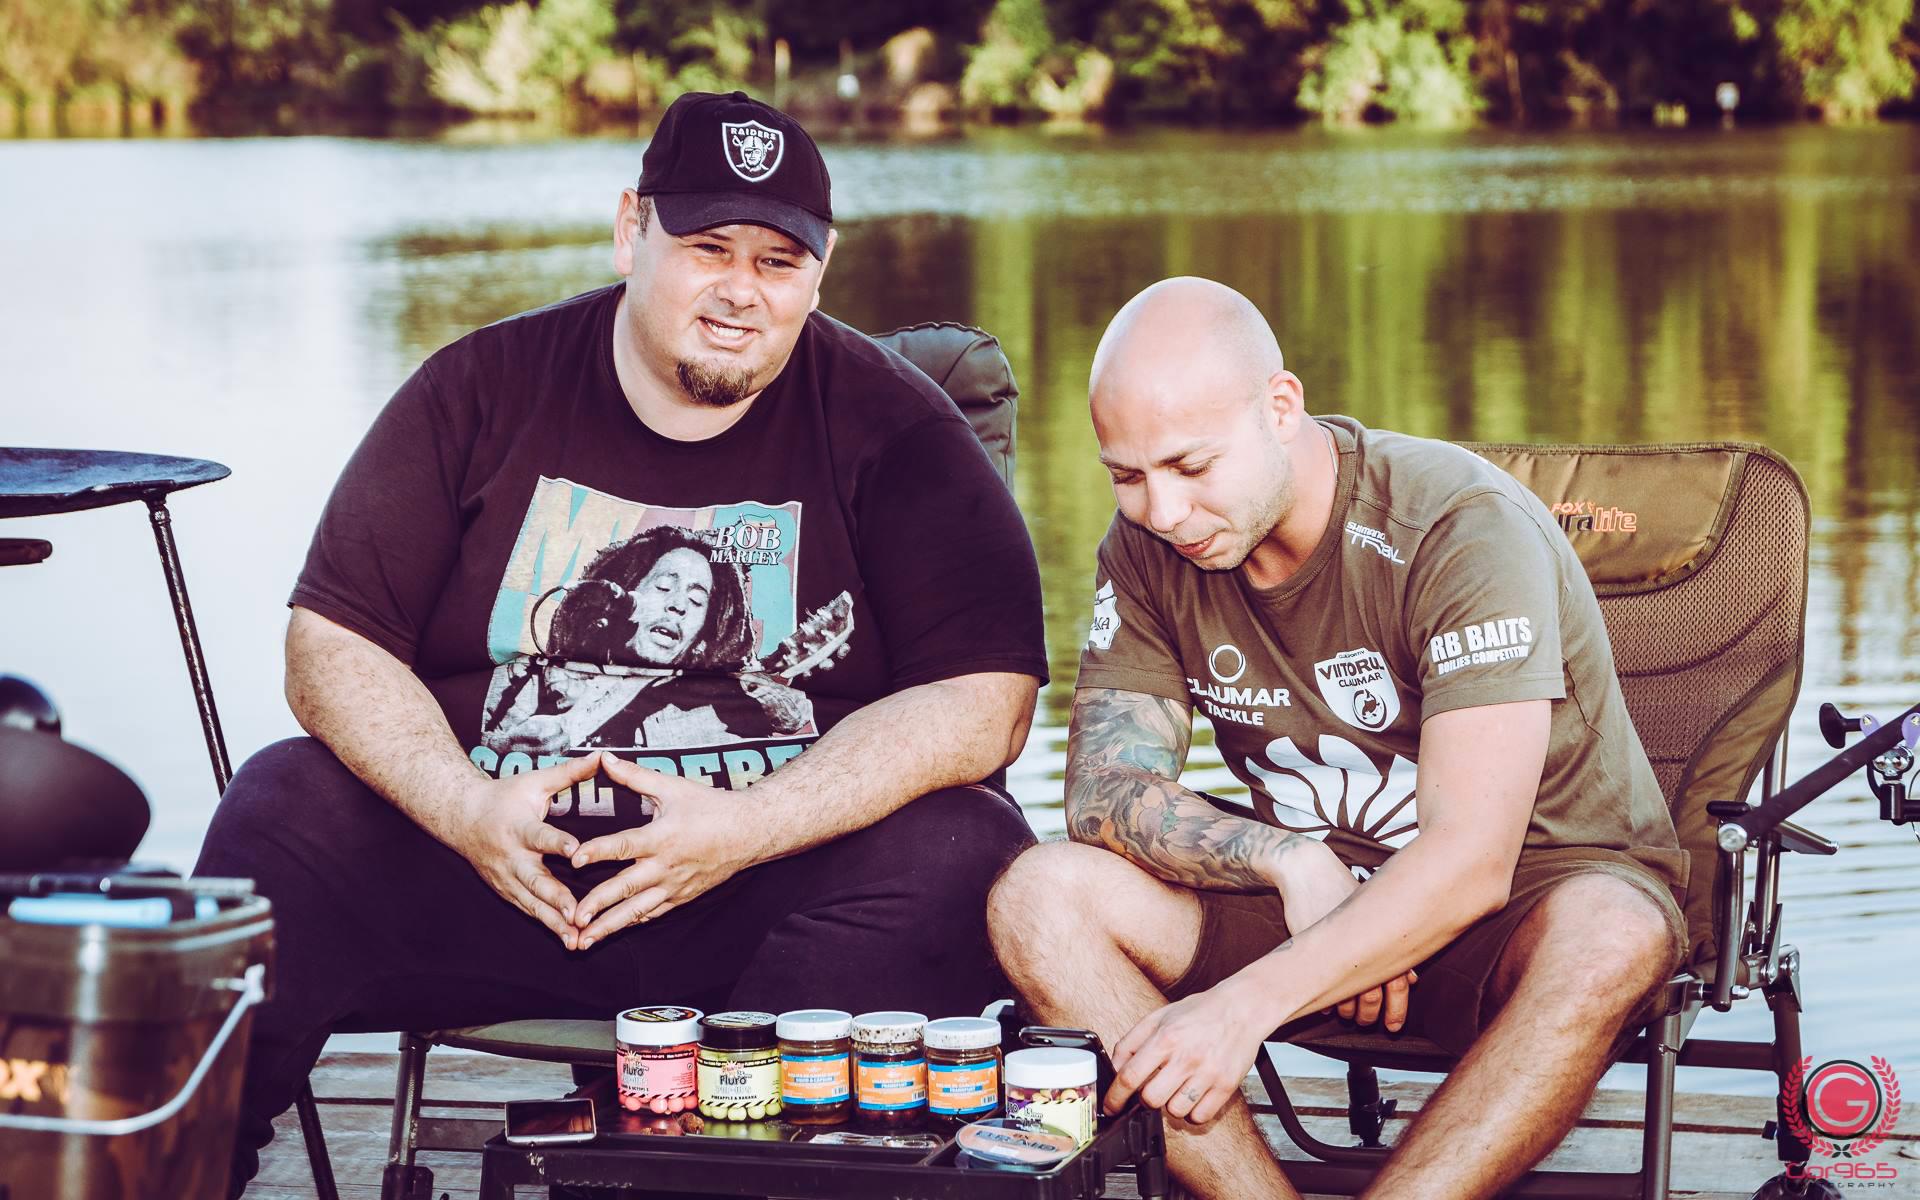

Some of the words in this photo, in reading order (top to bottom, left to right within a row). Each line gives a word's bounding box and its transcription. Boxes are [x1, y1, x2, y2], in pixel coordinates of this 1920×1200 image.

[730, 128, 776, 140] RAIDERS
[1551, 502, 1585, 514] FOX
[713, 525, 781, 550] BOB
[709, 549, 782, 565] MARLEY
[1430, 631, 1463, 663] RB
[1464, 616, 1533, 652] BAITS
[1318, 657, 1385, 680] VIITORUL
[1438, 654, 1471, 675] BOILIES
[1339, 672, 1383, 688] CLAUMAR
[1204, 700, 1264, 726] TACKLE
[623, 1063, 645, 1077] Fluro
[720, 1074, 747, 1086] Fluro
